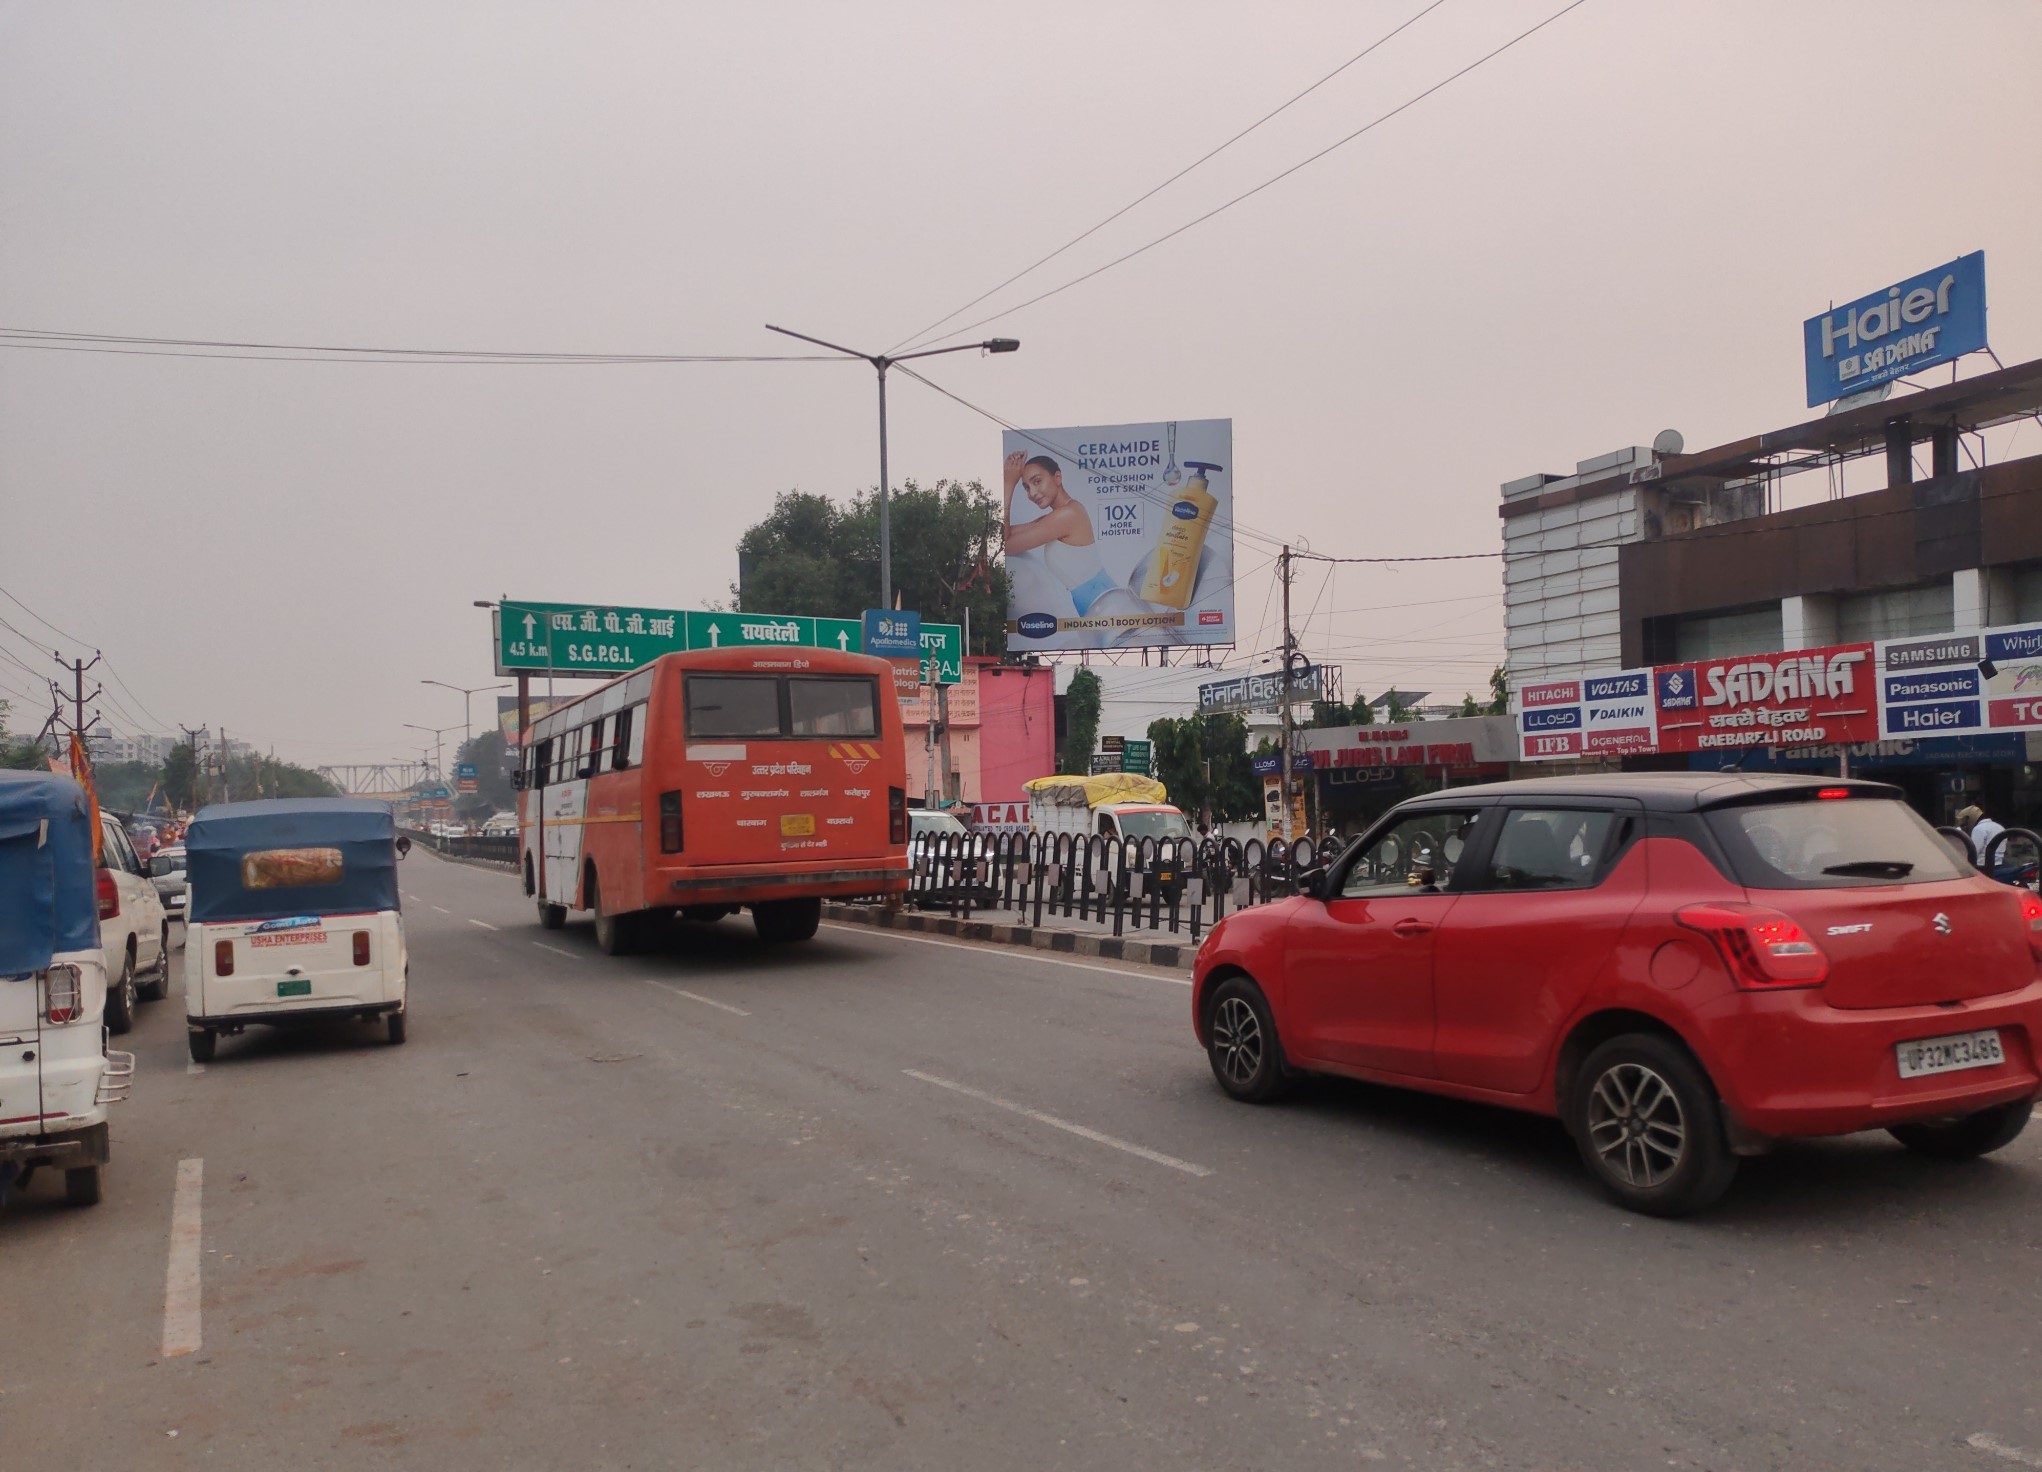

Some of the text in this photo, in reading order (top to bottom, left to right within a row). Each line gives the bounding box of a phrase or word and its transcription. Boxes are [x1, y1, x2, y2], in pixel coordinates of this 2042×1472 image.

[1821, 274, 1954, 358] Haier
[1862, 326, 1941, 373] SADANA
[1078, 440, 1160, 455] CERAMIDE
[1078, 454, 1160, 470] HYALURON
[1088, 473, 1154, 484] FOR CUSHION
[1096, 484, 1146, 494] SOFT SKIN
[1104, 504, 1137, 521] 10X
[1101, 528, 1141, 536] MOISTURE
[1110, 521, 1133, 529] MORE
[552, 610, 676, 639] एस. जी. पी. जी. आई
[1020, 620, 1055, 629] Vaseline
[1064, 620, 1094, 629] INDIA'S
[1116, 618, 1140, 627] BODY
[1142, 617, 1176, 626] LOTION
[740, 621, 800, 643] रायबरेली
[509, 641, 526, 657] 4.5
[870, 636, 917, 649] Apollomedics
[568, 643, 635, 664] S.G.P.G.I.
[1889, 644, 1971, 666] SAMSUNG
[793, 659, 810, 669] डिपो
[1591, 679, 1640, 697] VOLTAS
[1702, 651, 1867, 709] SADANA
[1890, 677, 1973, 697] Panasonic
[1201, 679, 1248, 706] सेनानी
[1528, 687, 1574, 702] HITACHI
[1661, 695, 1693, 708] SADANA
[1528, 712, 1576, 727] LLOYD
[1600, 706, 1645, 720] DAIKIN
[1708, 707, 1756, 728] सबसे
[1903, 707, 1962, 728] Haier
[1536, 736, 1570, 753] IFB
[1698, 727, 1826, 748] RAEBARELI ROAD
[1334, 747, 1382, 768] JURIS
[1386, 744, 1424, 765] LAW
[1427, 742, 1473, 765] FIRM
[1617, 747, 1629, 755] Top
[1638, 745, 1657, 754] Town
[752, 760, 812, 777] उत्तर प्रदेश परिवहन
[1254, 760, 1276, 769] LLOYD
[1329, 767, 1396, 785] LLOYD
[696, 790, 731, 799] लखनऊ
[736, 819, 767, 828] चारबाग
[1826, 923, 1873, 936] SWIFT
[250, 935, 273, 945] USHA
[274, 932, 328, 943] ENTERPRISES
